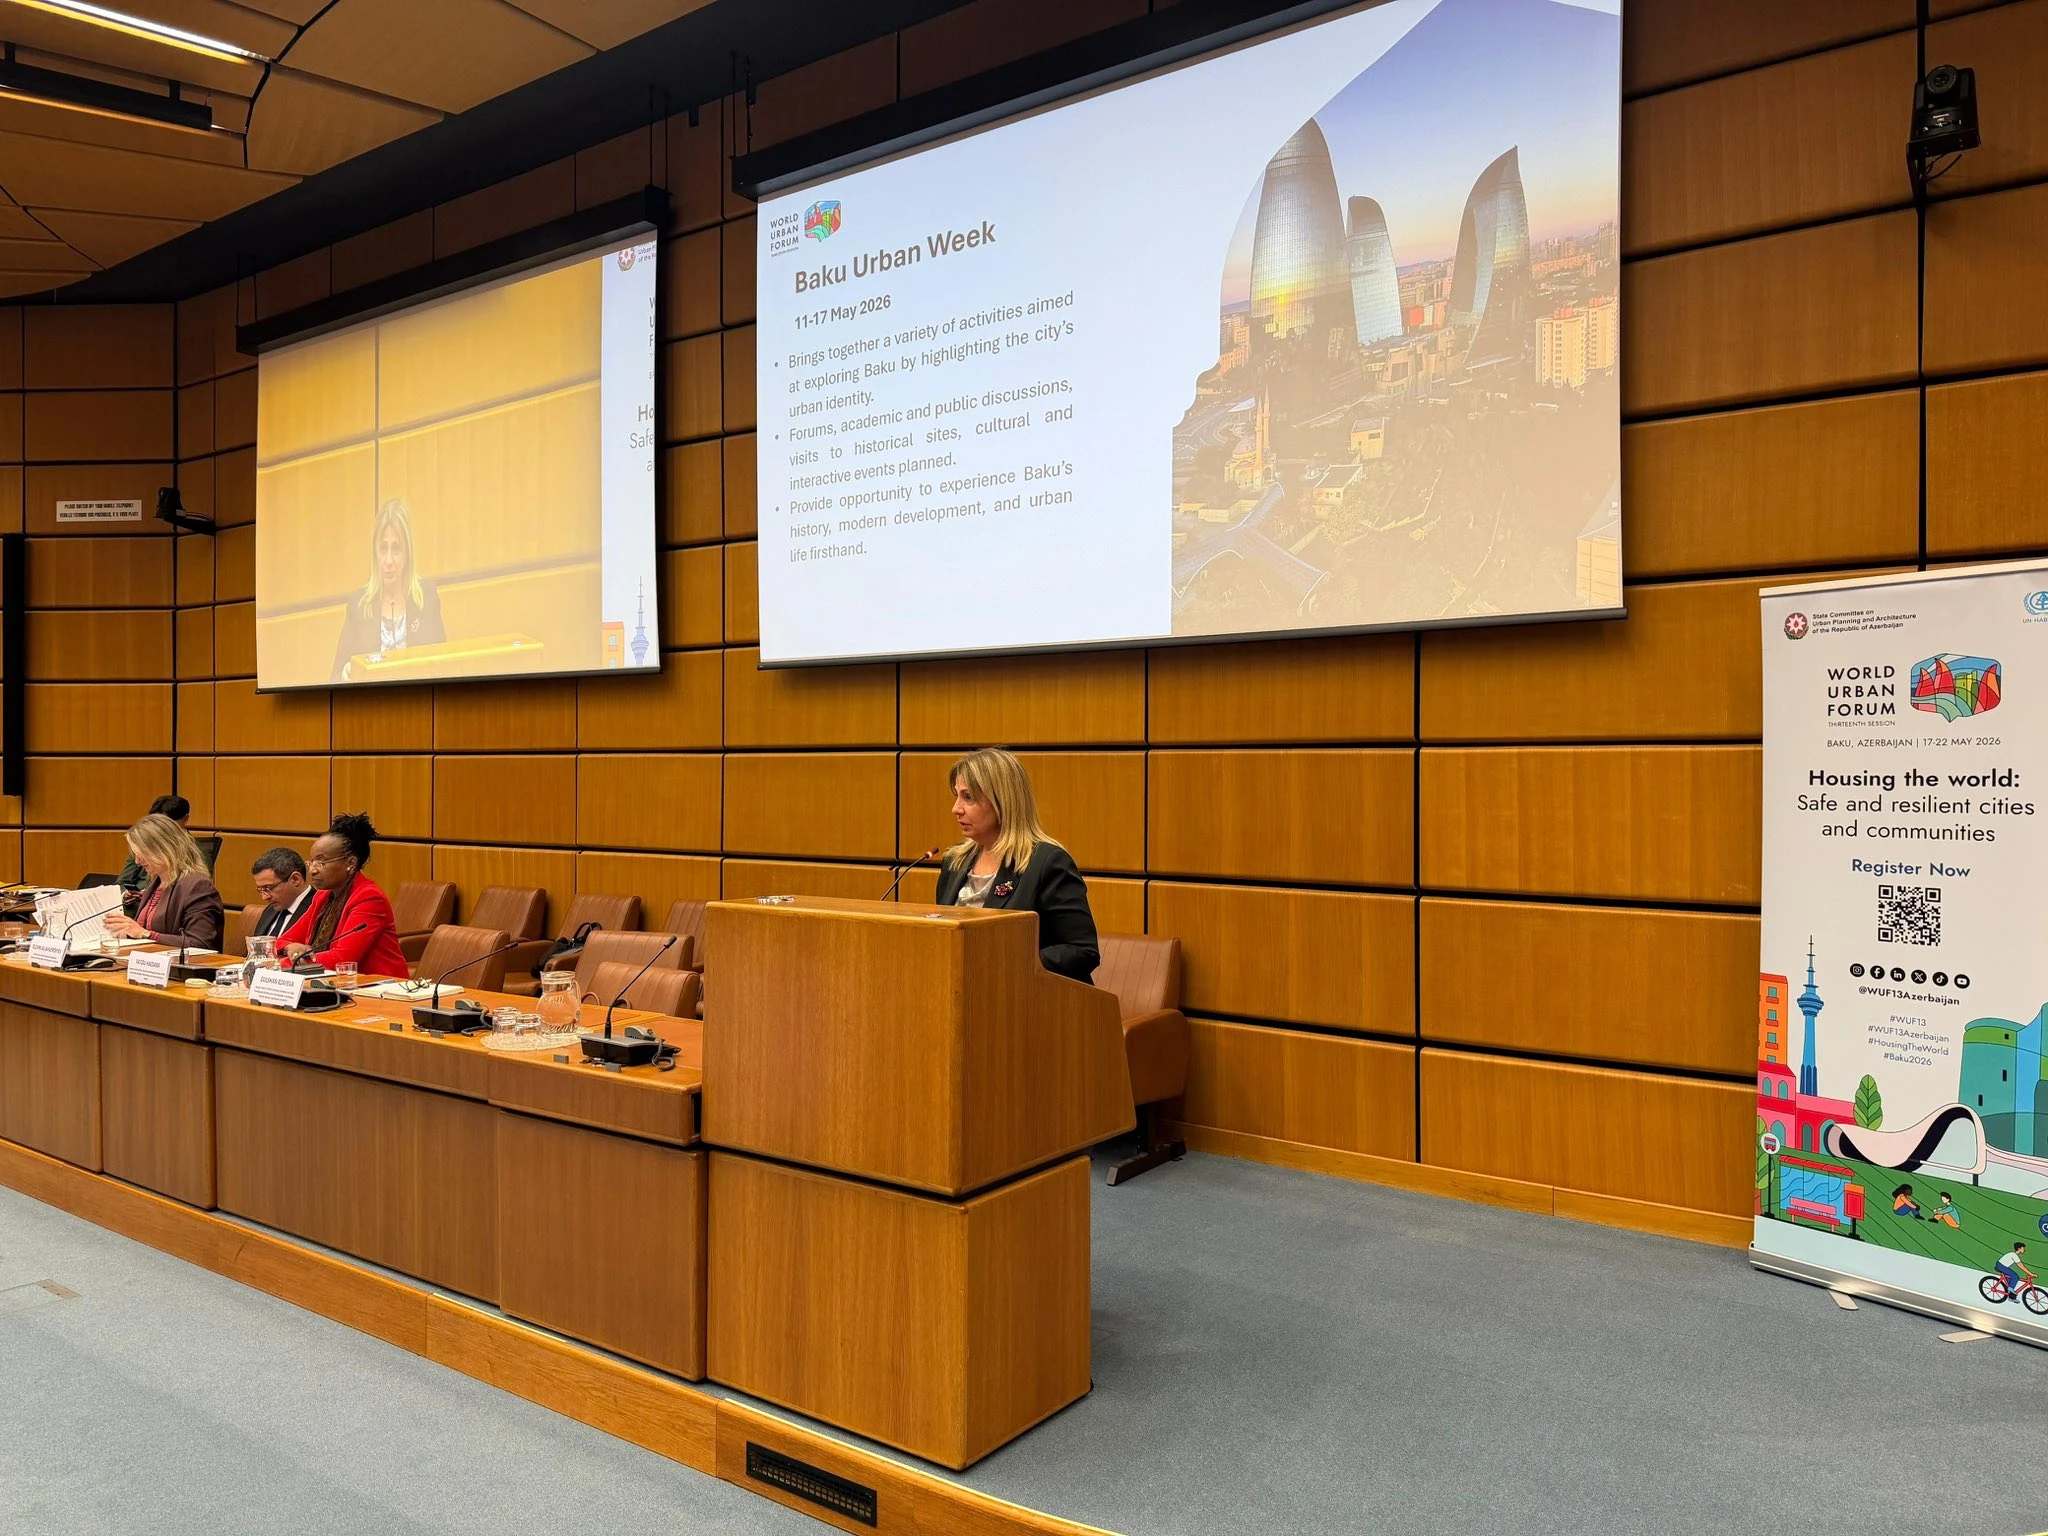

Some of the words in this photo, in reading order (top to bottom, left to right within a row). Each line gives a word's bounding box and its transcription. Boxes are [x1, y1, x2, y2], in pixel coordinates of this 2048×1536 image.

[770, 213, 799, 228] WORLD
[770, 225, 799, 240] URBAN
[770, 236, 799, 251] FORUM
[795, 263, 846, 294] Baku
[853, 244, 920, 279] Urban
[927, 220, 996, 258] Week
[795, 310, 828, 330] 11-17
[830, 306, 857, 321] May
[860, 295, 891, 314] 2026
[788, 351, 825, 368] Brings
[828, 338, 880, 360] together
[884, 336, 891, 348] a
[894, 324, 938, 344] variety
[942, 318, 956, 334] of
[960, 306, 1022, 330] activities
[1027, 290, 1074, 314] aimed
[788, 380, 800, 393] at
[804, 367, 860, 390] exploring
[864, 360, 896, 378] Baku
[901, 356, 916, 372] by
[922, 338, 1000, 366] highlighting
[1005, 332, 1029, 348] the
[789, 401, 822, 418] urban
[826, 390, 874, 410] identity.
[789, 423, 837, 442] Forums,
[841, 409, 902, 432] academic
[906, 402, 930, 420] and
[935, 395, 978, 418] public
[982, 380, 1072, 406] discussions,
[789, 450, 818, 466] visits
[830, 446, 842, 459] to
[854, 433, 914, 456] historical
[926, 427, 962, 443] sites,
[976, 412, 1030, 434] cultural
[1045, 404, 1072, 422] and
[790, 470, 851, 490] interactive
[854, 463, 896, 480] events
[899, 452, 956, 477] planned.
[790, 496, 832, 514] Provide
[840, 486, 912, 509] opportunity
[920, 483, 932, 496] to
[940, 471, 1016, 494] experience
[790, 523, 832, 538] history,
[840, 516, 886, 532] modern
[894, 501, 986, 525] development,
[994, 494, 1020, 512] and
[1030, 490, 1072, 508] urban
[790, 548, 807, 562] life
[810, 541, 868, 560] firsthand.
[1828, 666, 1895, 681] WORLD
[1828, 684, 1895, 699] URBAN
[1828, 703, 1895, 716] FORUM
[1827, 739, 1854, 748] BAKU,
[1857, 738, 1913, 748] AZERBAIJAN
[1923, 738, 1948, 746] 17-22
[1951, 738, 1973, 746] MAY
[1976, 737, 2001, 746] 2026
[1809, 770, 1895, 791] Housing
[1904, 768, 1938, 786] the
[1948, 768, 2020, 788] world:
[1797, 794, 1838, 811] Safe
[1846, 794, 1882, 812] and
[1892, 795, 1971, 814] resilient
[1979, 796, 2035, 815] cities
[1822, 820, 1858, 837] and
[1867, 824, 1995, 842] communities
[1852, 859, 1922, 877] Register
[1930, 862, 1970, 877] Now
[1858, 986, 1960, 1006] @WUF13Azerbaijan
[1890, 1015, 1927, 1026] #WUF13
[1868, 1025, 1950, 1042] #WUF13Azerbaijan
[1868, 1037, 1949, 1056] #HousingTheWorld
[1884, 1052, 1932, 1066] #Baku2026
